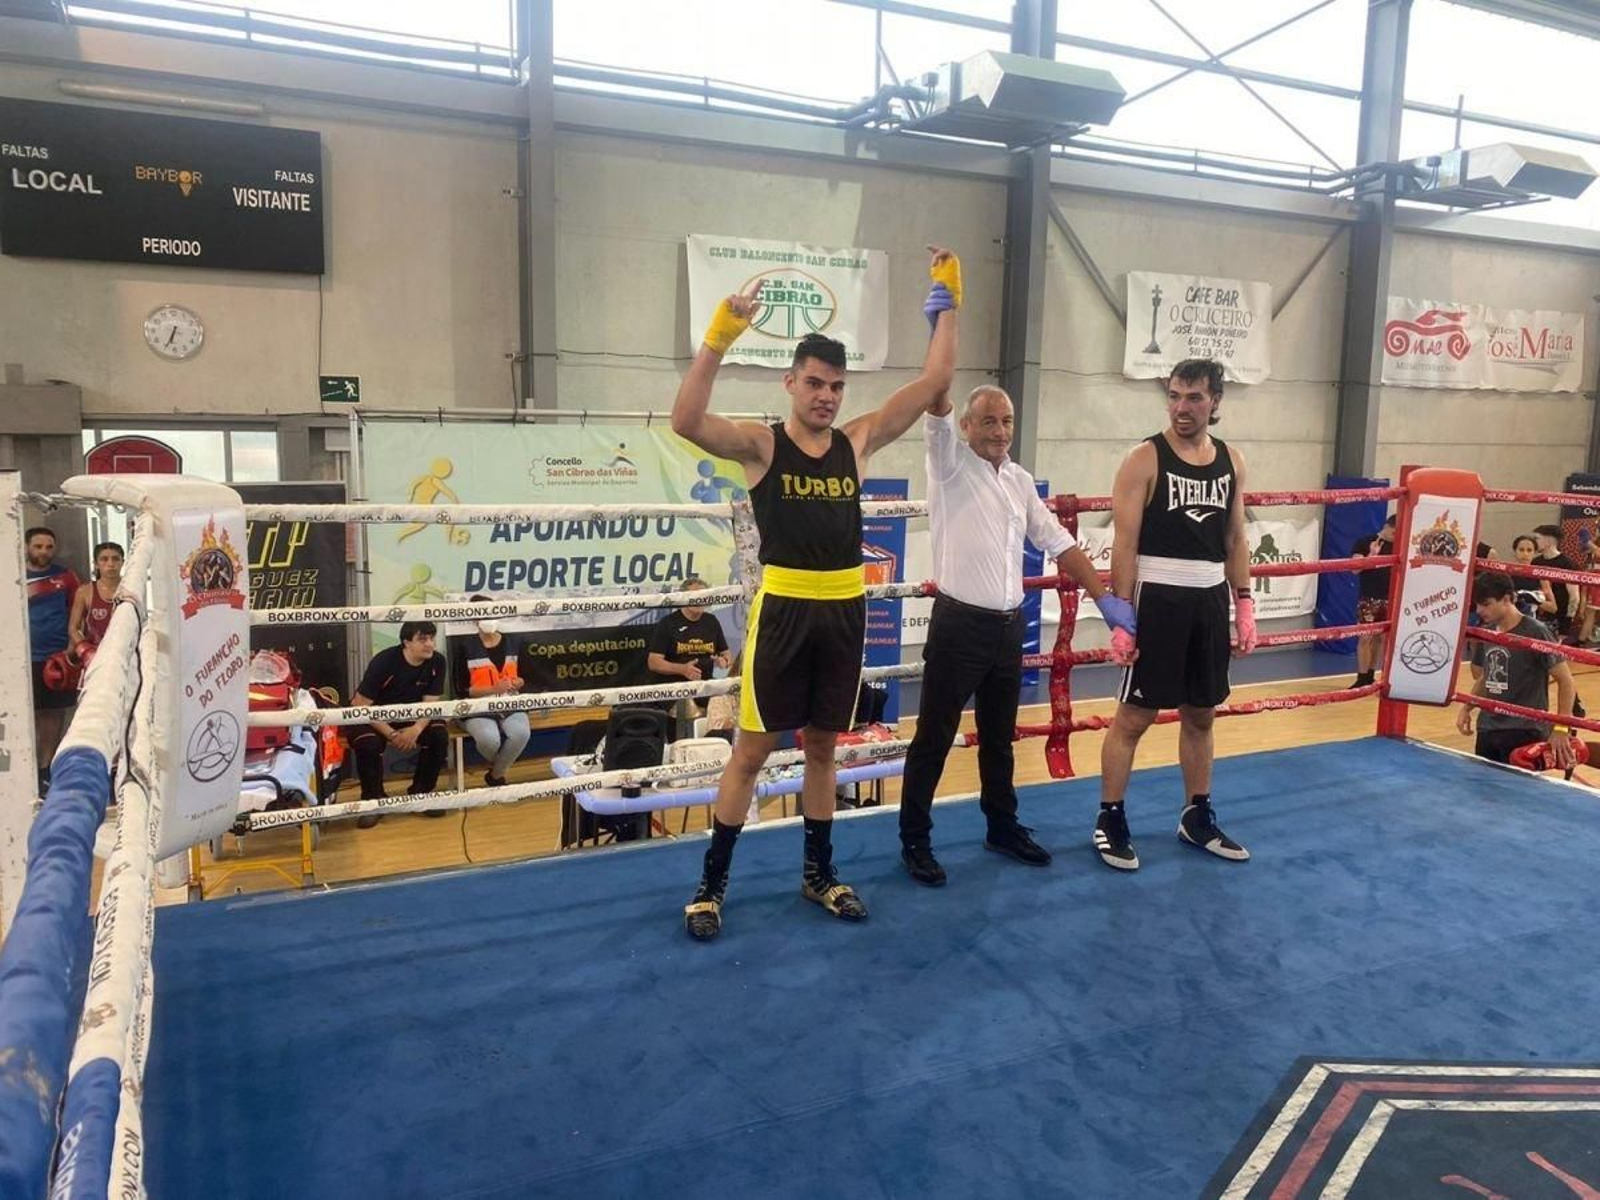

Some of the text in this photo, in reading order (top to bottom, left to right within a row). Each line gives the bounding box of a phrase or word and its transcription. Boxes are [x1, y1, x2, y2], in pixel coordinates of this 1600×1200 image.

[1, 144, 49, 160] FALTAS
[12, 168, 103, 195] LOCAL
[274, 170, 315, 184] FALTAS
[233, 187, 311, 212] VISITANTE
[142, 237, 201, 257] PERIODO
[756, 290, 822, 305] CIBRAO
[1215, 288, 1240, 307] BAR
[1170, 305, 1180, 322] O
[546, 457, 582, 466] Concello
[546, 468, 638, 477] San Cibrao das Viñas
[781, 474, 856, 497] TURBO
[1166, 471, 1232, 511] EVERLAST
[464, 552, 700, 593] DEPORTE LOCAL
[424, 605, 518, 620] BOXBRONX.COM
[562, 601, 646, 612] BOXBRONX.COM
[268, 611, 370, 623] BOXBRONX.COM
[527, 640, 566, 658] Copa
[194, 633, 241, 687] FURANCHO
[556, 660, 619, 680] BOXEO
[199, 655, 244, 710] DO FLORO
[488, 696, 575, 710] BOXBRONX.COM
[619, 689, 698, 702] BOXBRONX.COM
